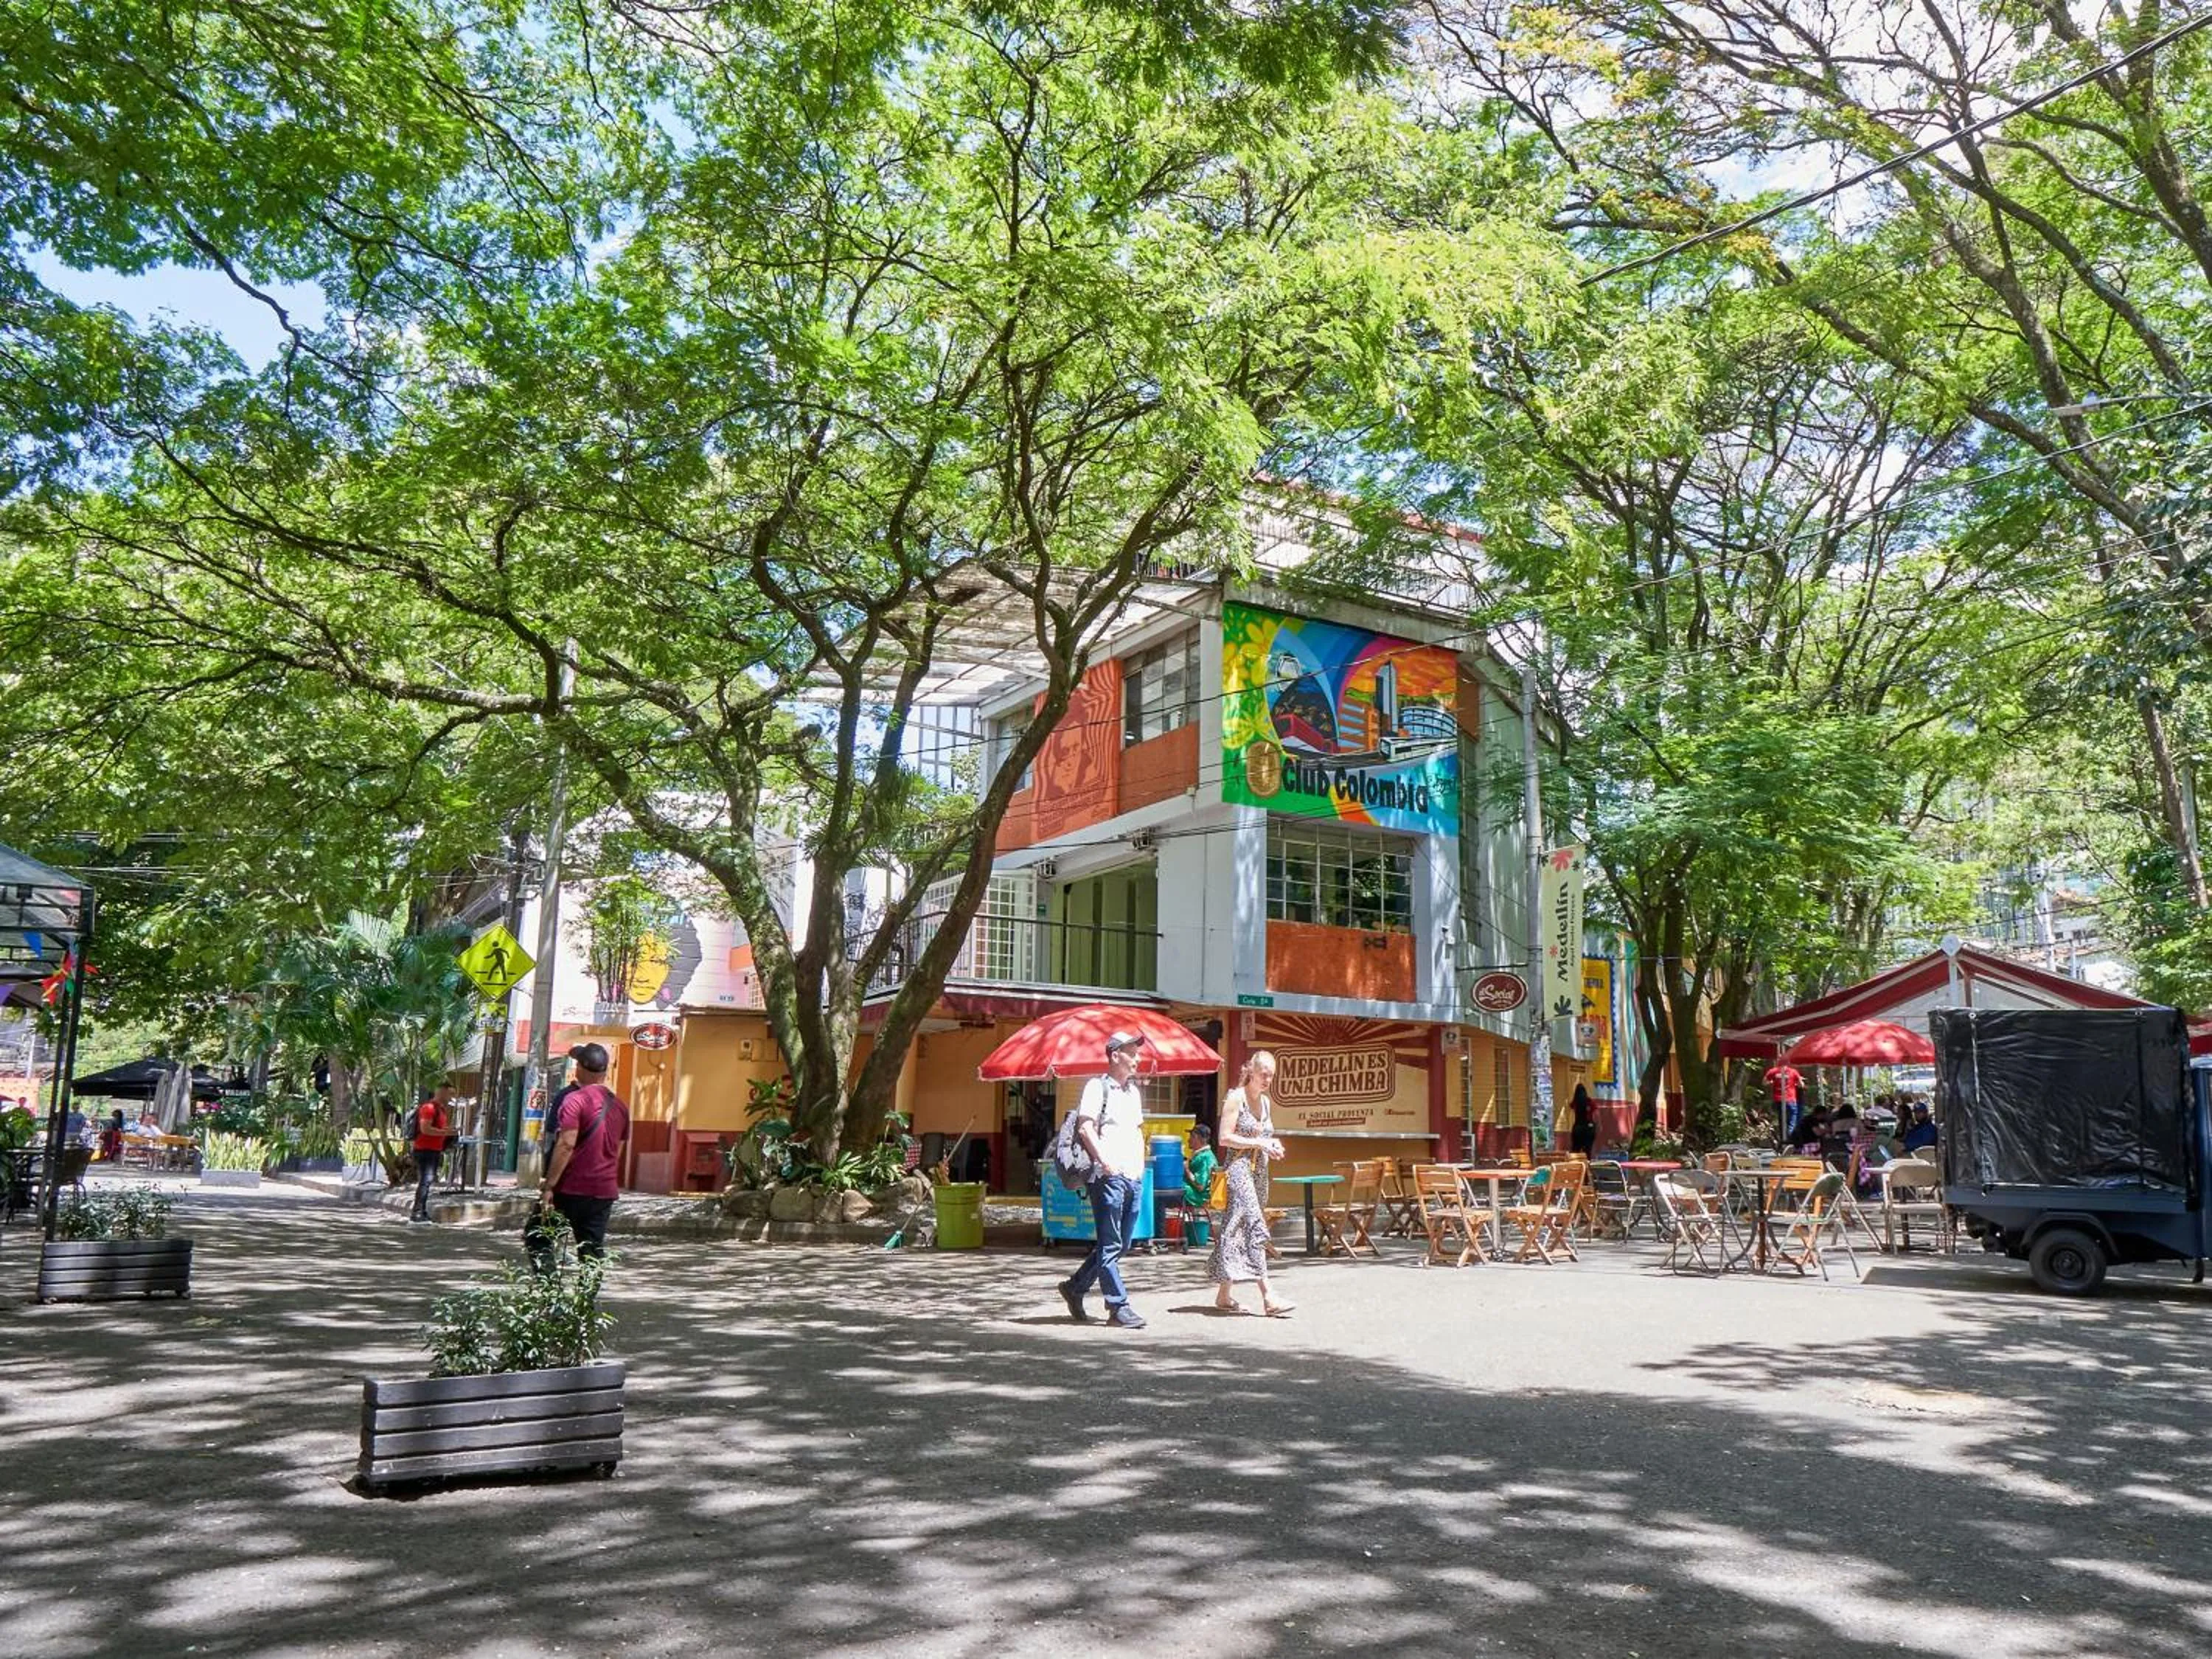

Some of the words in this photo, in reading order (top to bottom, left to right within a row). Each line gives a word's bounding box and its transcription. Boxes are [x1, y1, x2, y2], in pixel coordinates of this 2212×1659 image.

[1282, 758, 1329, 797] Club
[1335, 766, 1428, 813] Colombia
[1556, 881, 1568, 981] Medellín
[1368, 1053, 1386, 1068] ES
[1281, 1078, 1314, 1095] UNA
[1318, 1071, 1386, 1093] CHIMBA
